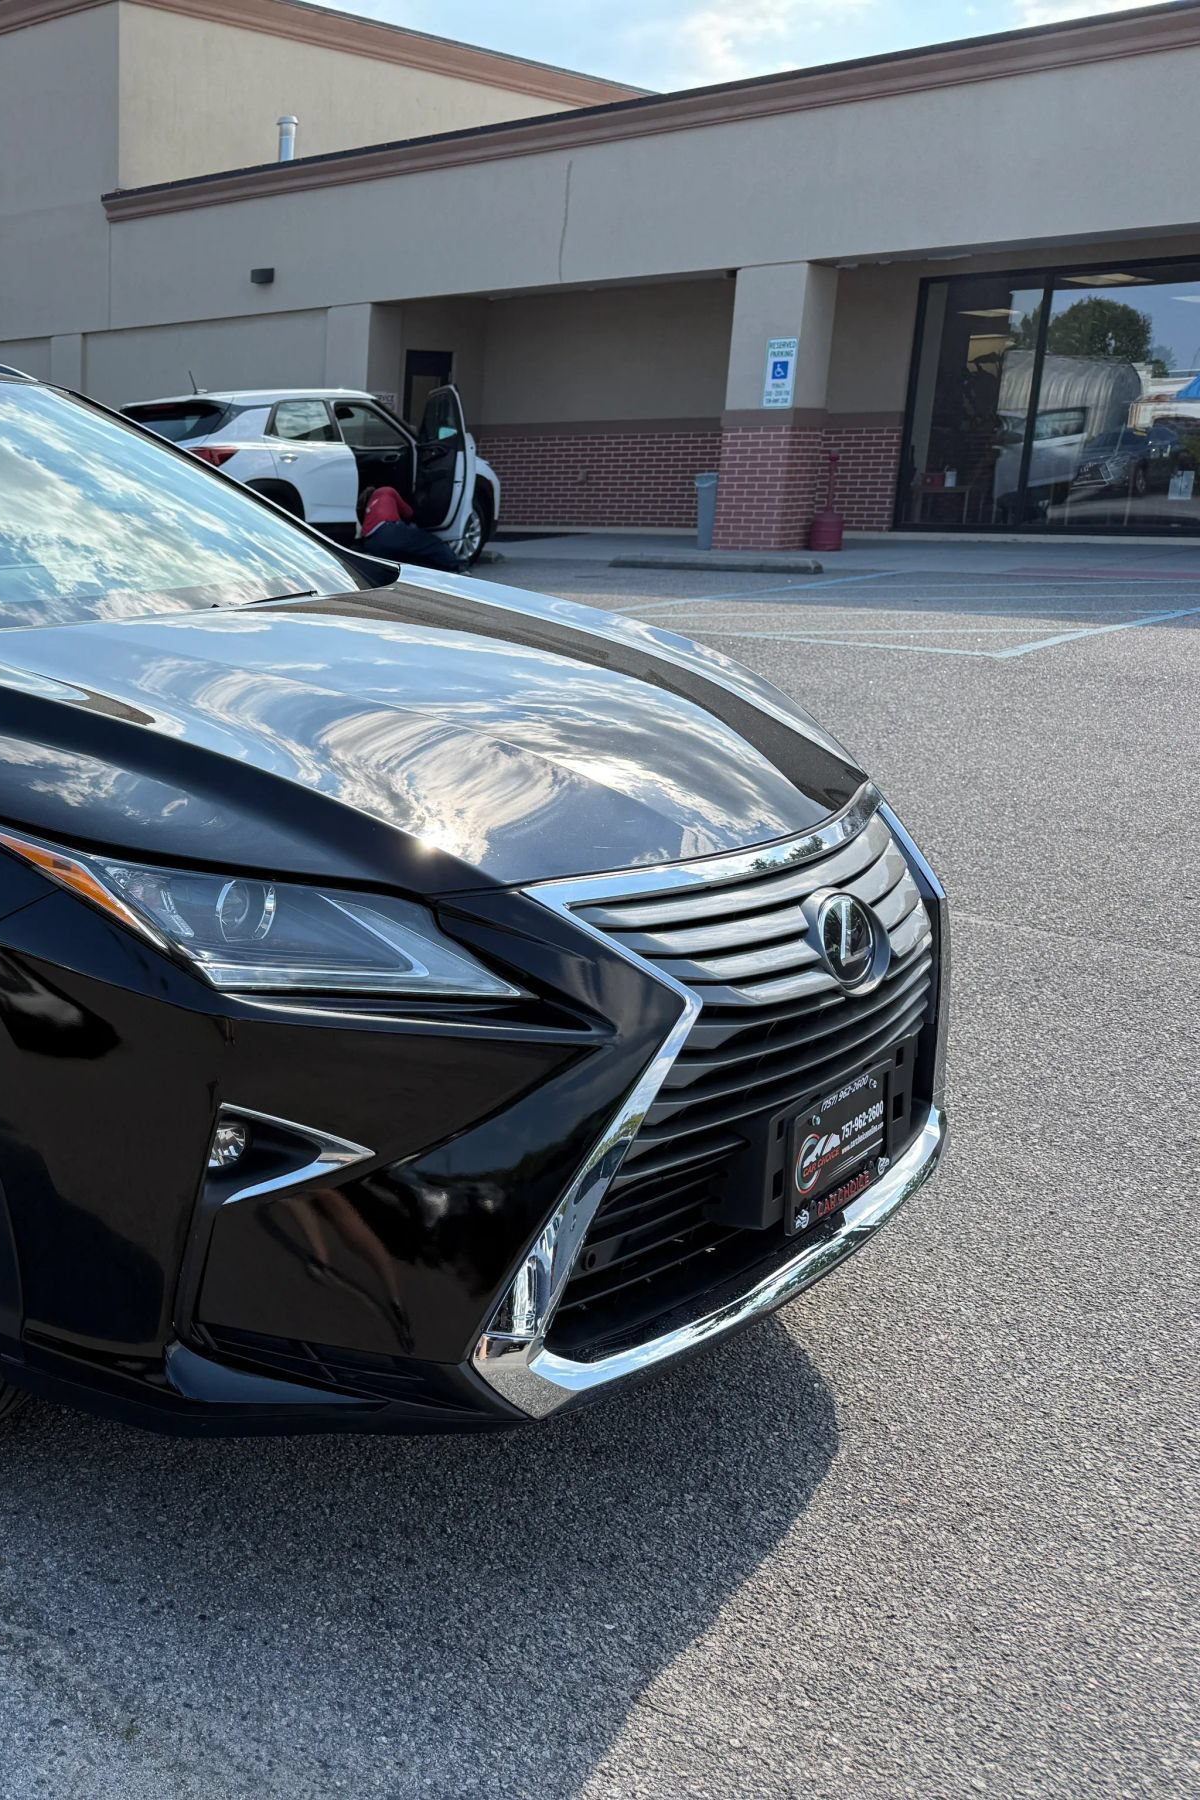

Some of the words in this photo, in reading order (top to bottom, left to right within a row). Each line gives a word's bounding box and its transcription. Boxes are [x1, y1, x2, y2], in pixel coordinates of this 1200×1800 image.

[841, 1100, 884, 1141] 757-962-2600
[803, 1163, 817, 1177] CAR
[817, 1147, 840, 1167] CHOICE
[817, 1193, 837, 1217] CAR
[837, 1170, 870, 1204] CHOICE
